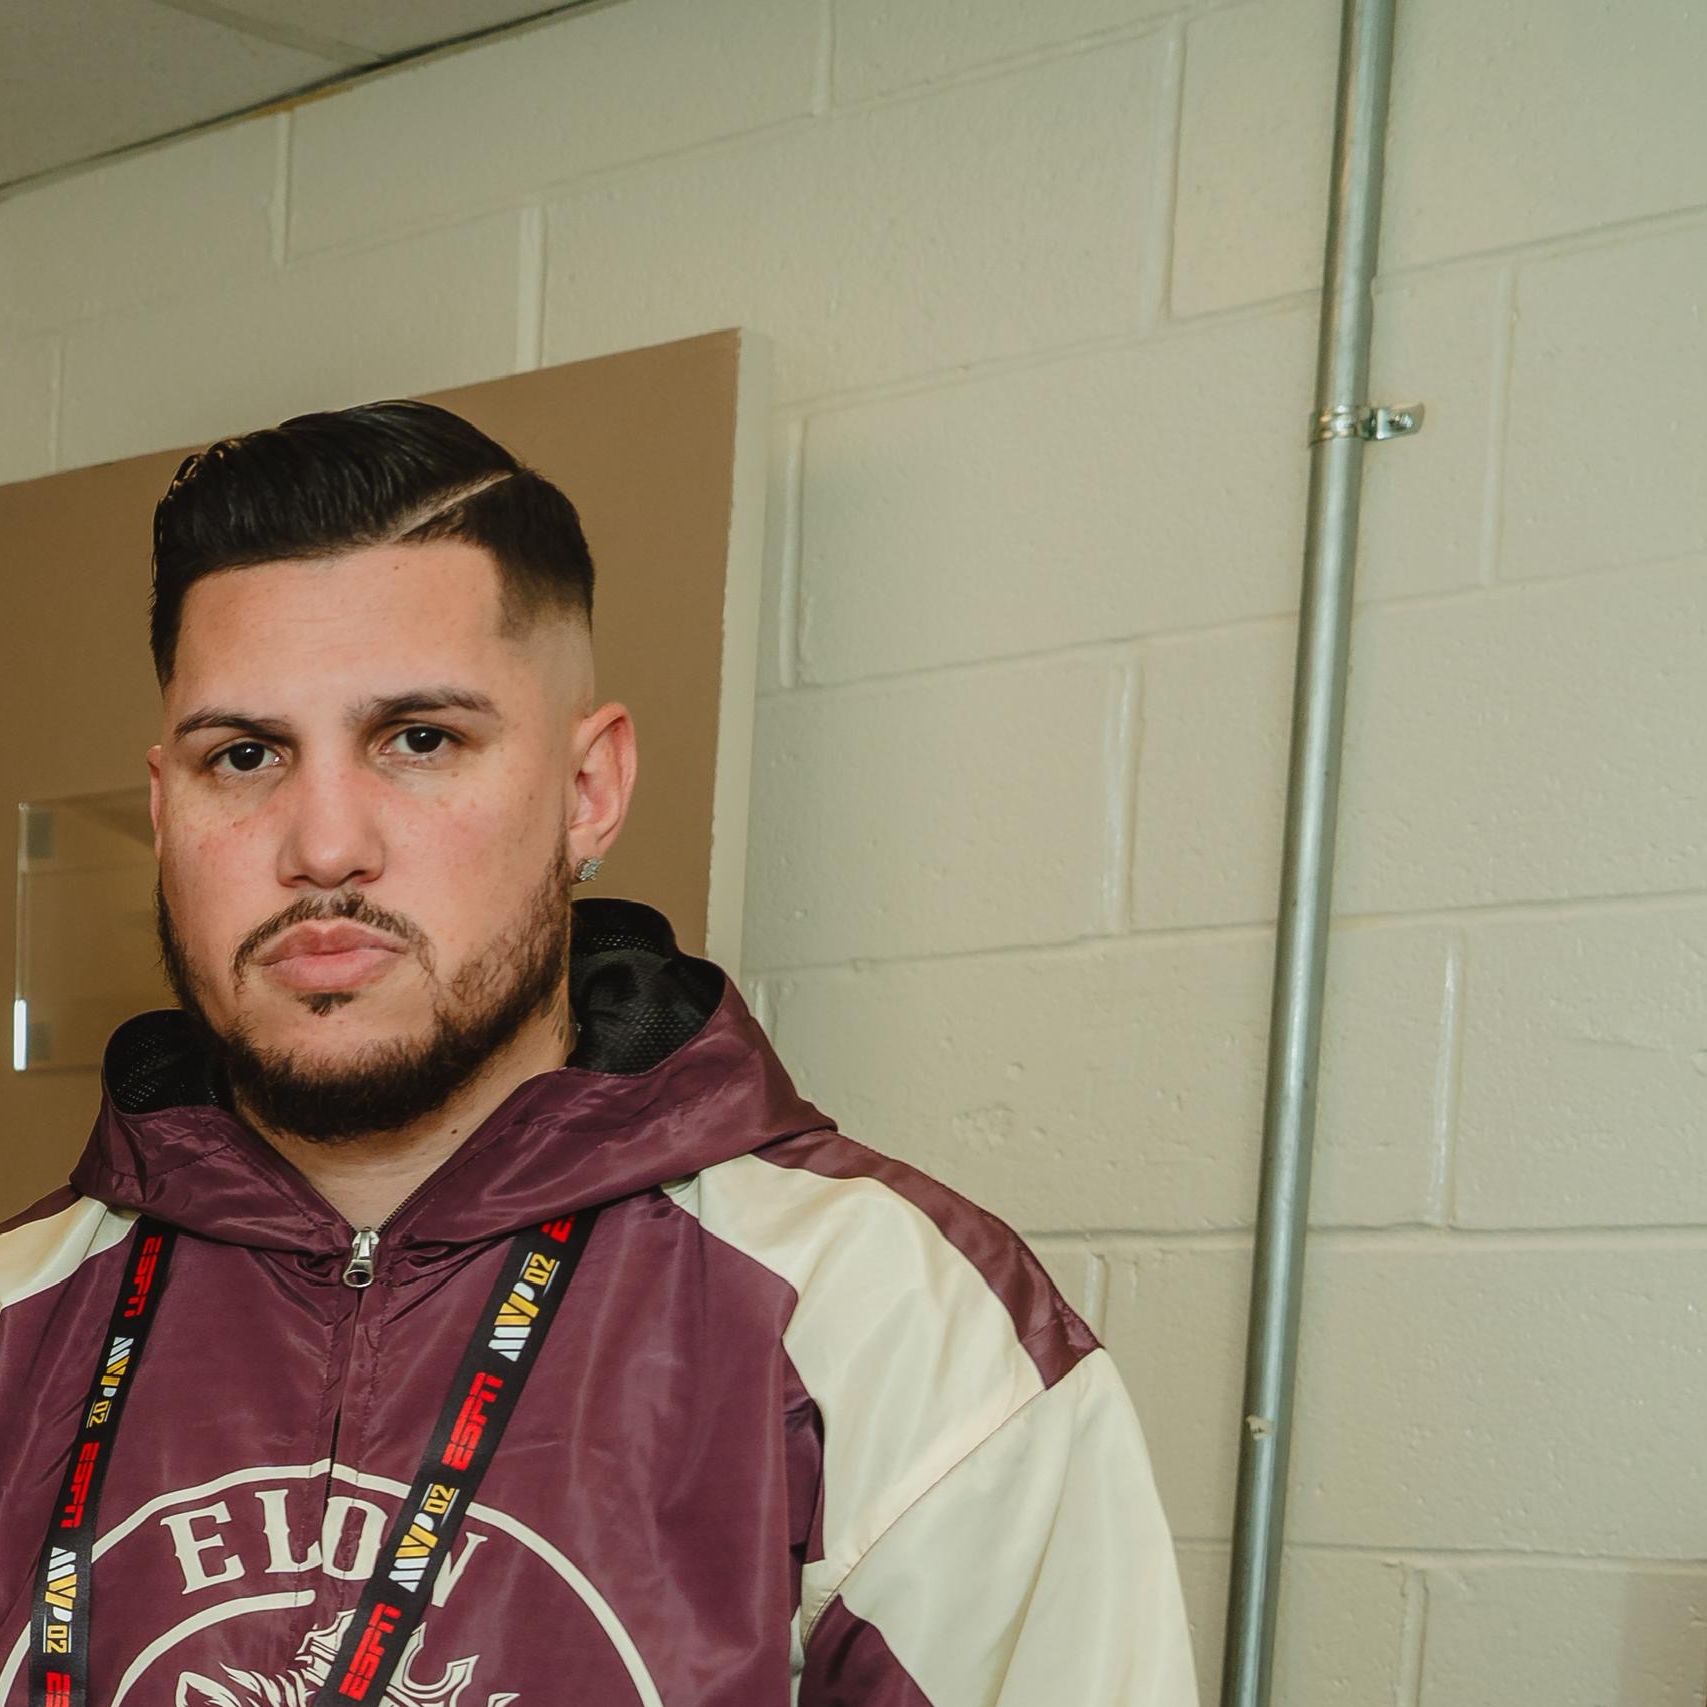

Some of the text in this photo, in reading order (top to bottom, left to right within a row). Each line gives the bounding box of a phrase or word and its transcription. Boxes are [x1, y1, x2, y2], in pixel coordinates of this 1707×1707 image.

[124, 1235, 162, 1318] ESPN
[488, 1283, 541, 1361] MVP
[528, 1251, 560, 1287] 02
[89, 1400, 109, 1428] 02
[442, 1372, 504, 1471] ESPN
[60, 1442, 101, 1528] ESPN
[388, 1484, 456, 1593] MVP 02
[44, 1547, 76, 1653] MVP 02
[339, 1603, 403, 1702] ESPN
